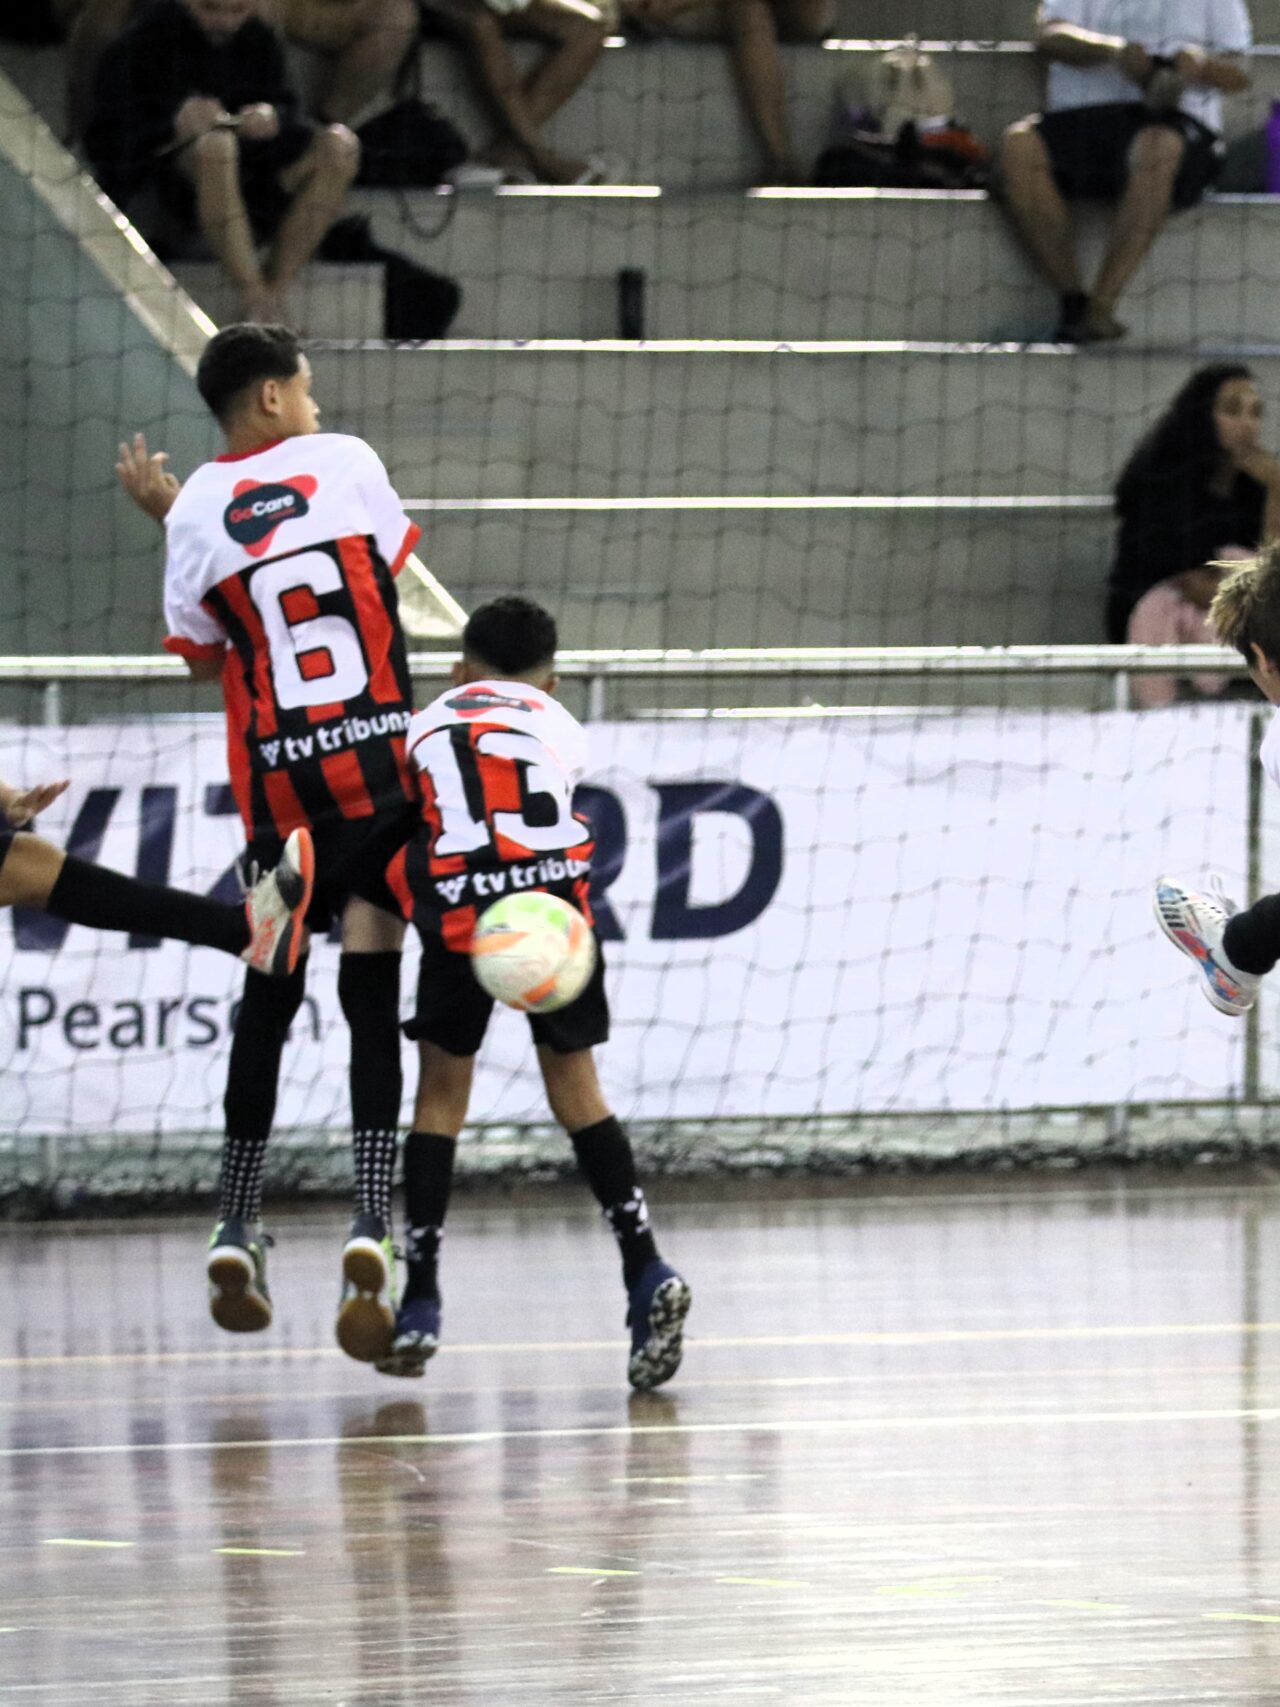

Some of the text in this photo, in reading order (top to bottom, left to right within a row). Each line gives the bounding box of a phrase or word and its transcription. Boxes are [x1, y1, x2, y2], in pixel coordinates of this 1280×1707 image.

[249, 550, 368, 710] 6
[283, 734, 314, 761] tv
[411, 728, 590, 857] 13
[471, 871, 507, 896] tv
[18, 987, 321, 1050] Pearsn
